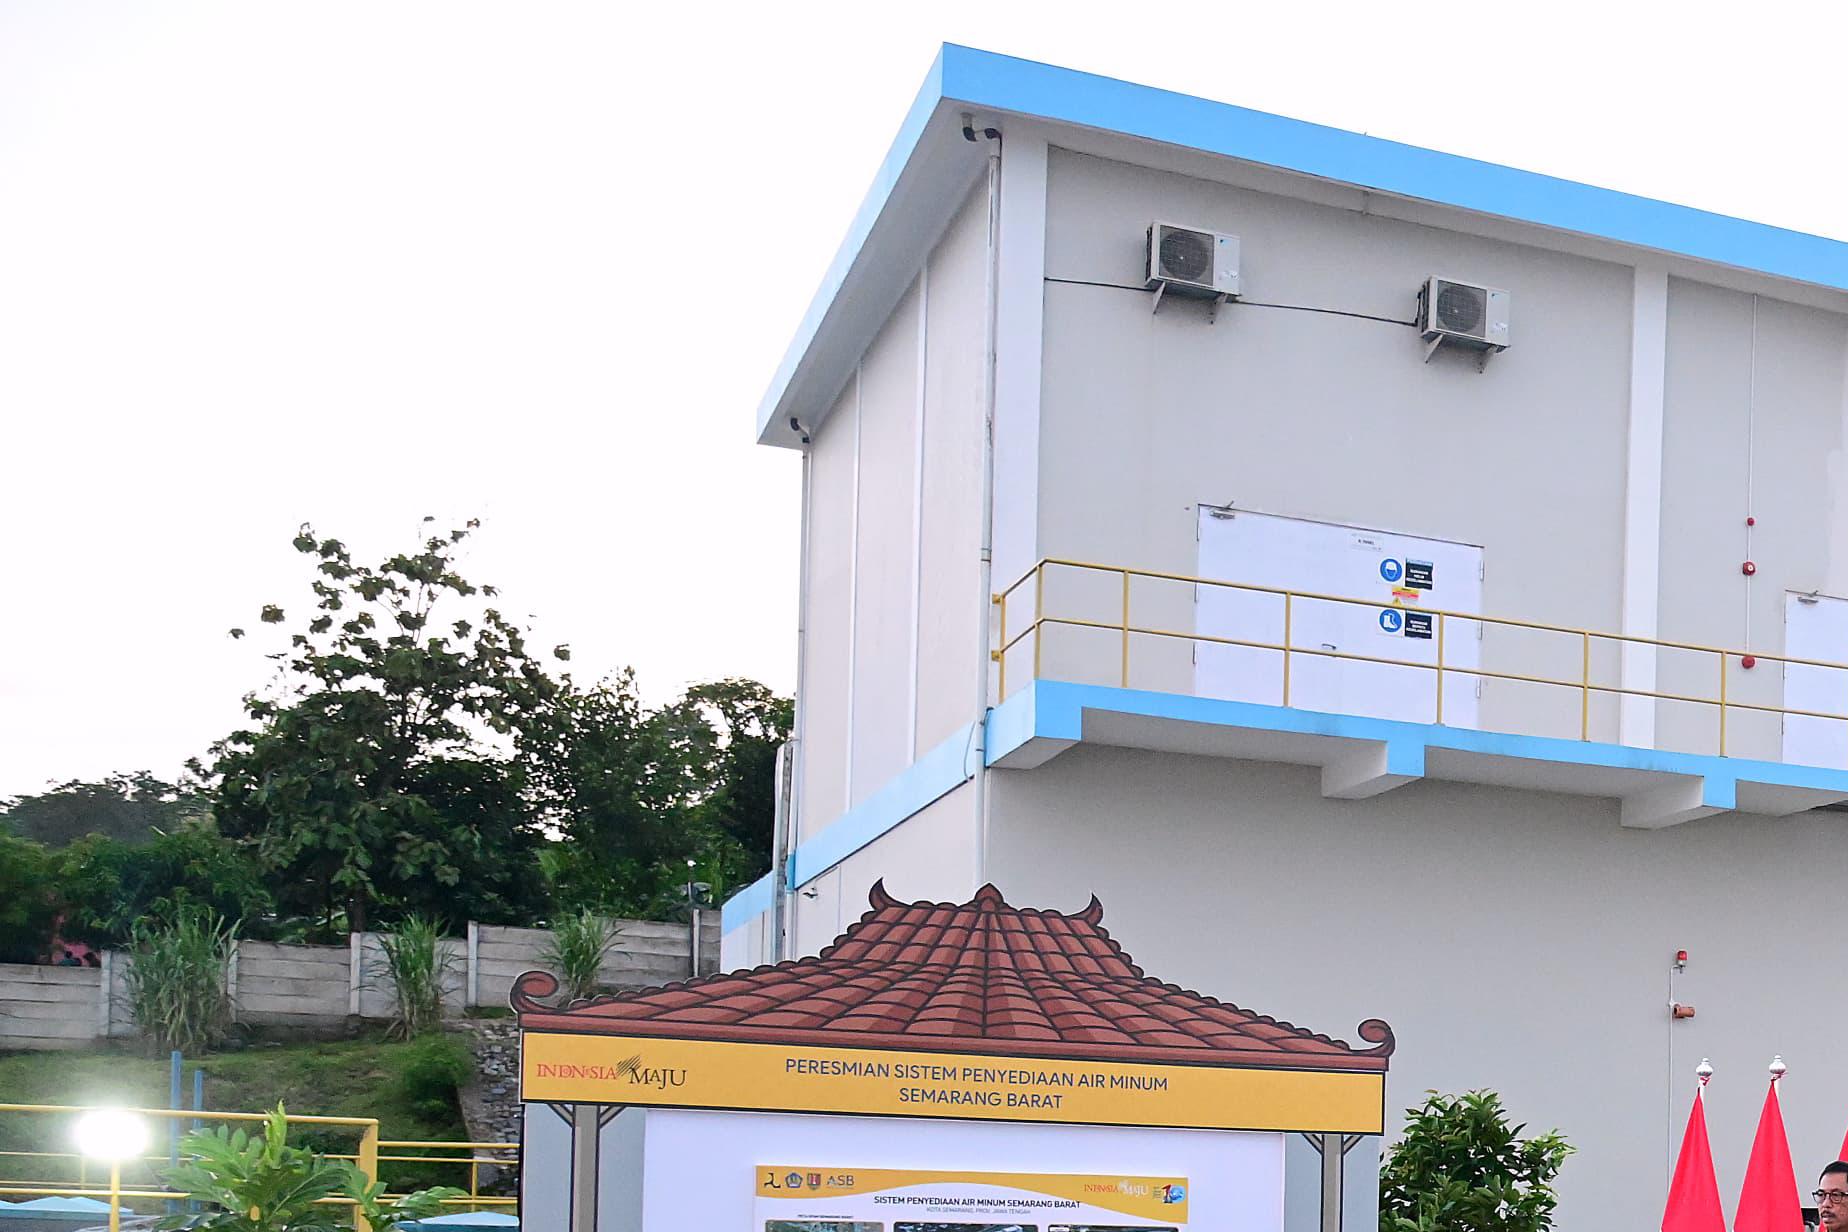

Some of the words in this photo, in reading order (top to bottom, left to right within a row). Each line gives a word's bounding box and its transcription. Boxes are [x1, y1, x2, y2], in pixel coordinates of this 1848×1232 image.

[628, 1067, 688, 1090] MAJU
[786, 1058, 889, 1078] PERESMIAN
[894, 1063, 957, 1081] SISTEM
[962, 1067, 1074, 1087] PENYEDIAAN
[1077, 1072, 1105, 1088] AIR
[1110, 1073, 1168, 1091] MINUM
[899, 1087, 1002, 1106] SEMARANG
[1006, 1092, 1063, 1109] BARAT
[826, 1174, 855, 1187] ASB
[873, 1195, 905, 1205] SISTEM
[906, 1196, 960, 1207] PENYEDIAAN
[961, 1197, 976, 1207] AIR
[977, 1198, 1006, 1207] MINUM
[1007, 1199, 1052, 1209] SEMARANG
[1054, 1200, 1081, 1209] BARAT
